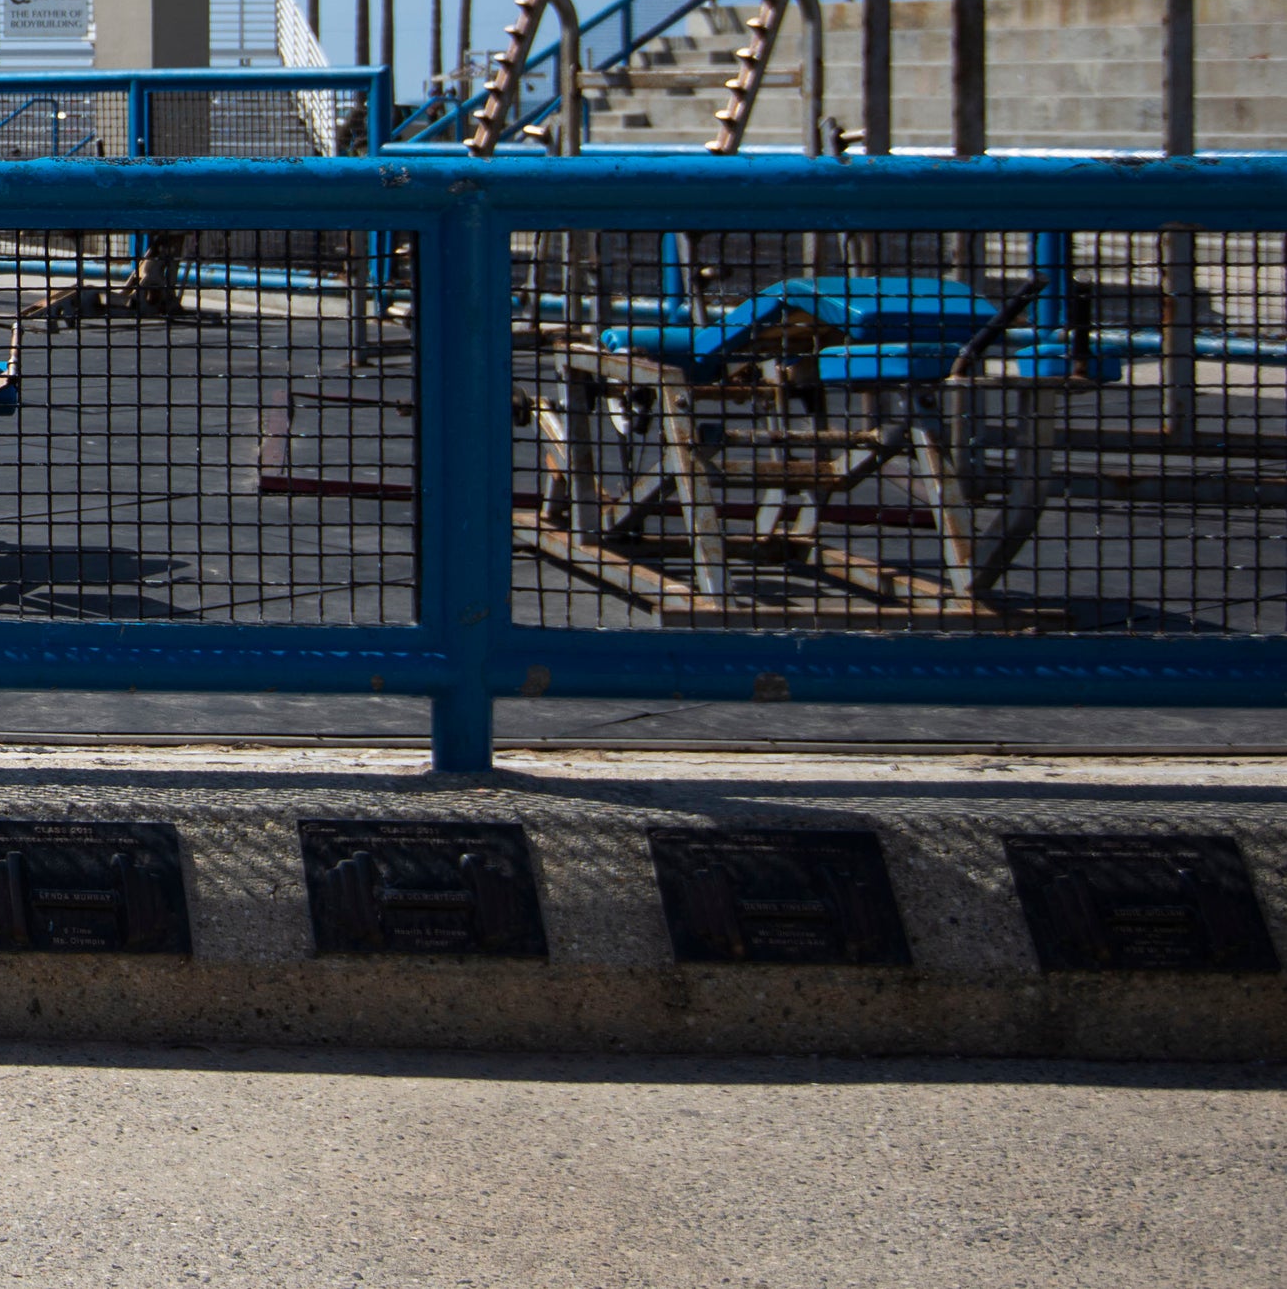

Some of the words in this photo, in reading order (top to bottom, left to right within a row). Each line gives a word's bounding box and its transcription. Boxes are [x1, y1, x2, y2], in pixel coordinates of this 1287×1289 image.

[10, 10, 29, 18] THE
[32, 10, 67, 18] FATHER
[69, 10, 82, 18] OF
[10, 20, 82, 28] BODYBUILDING
[70, 937, 105, 945] Olympia
